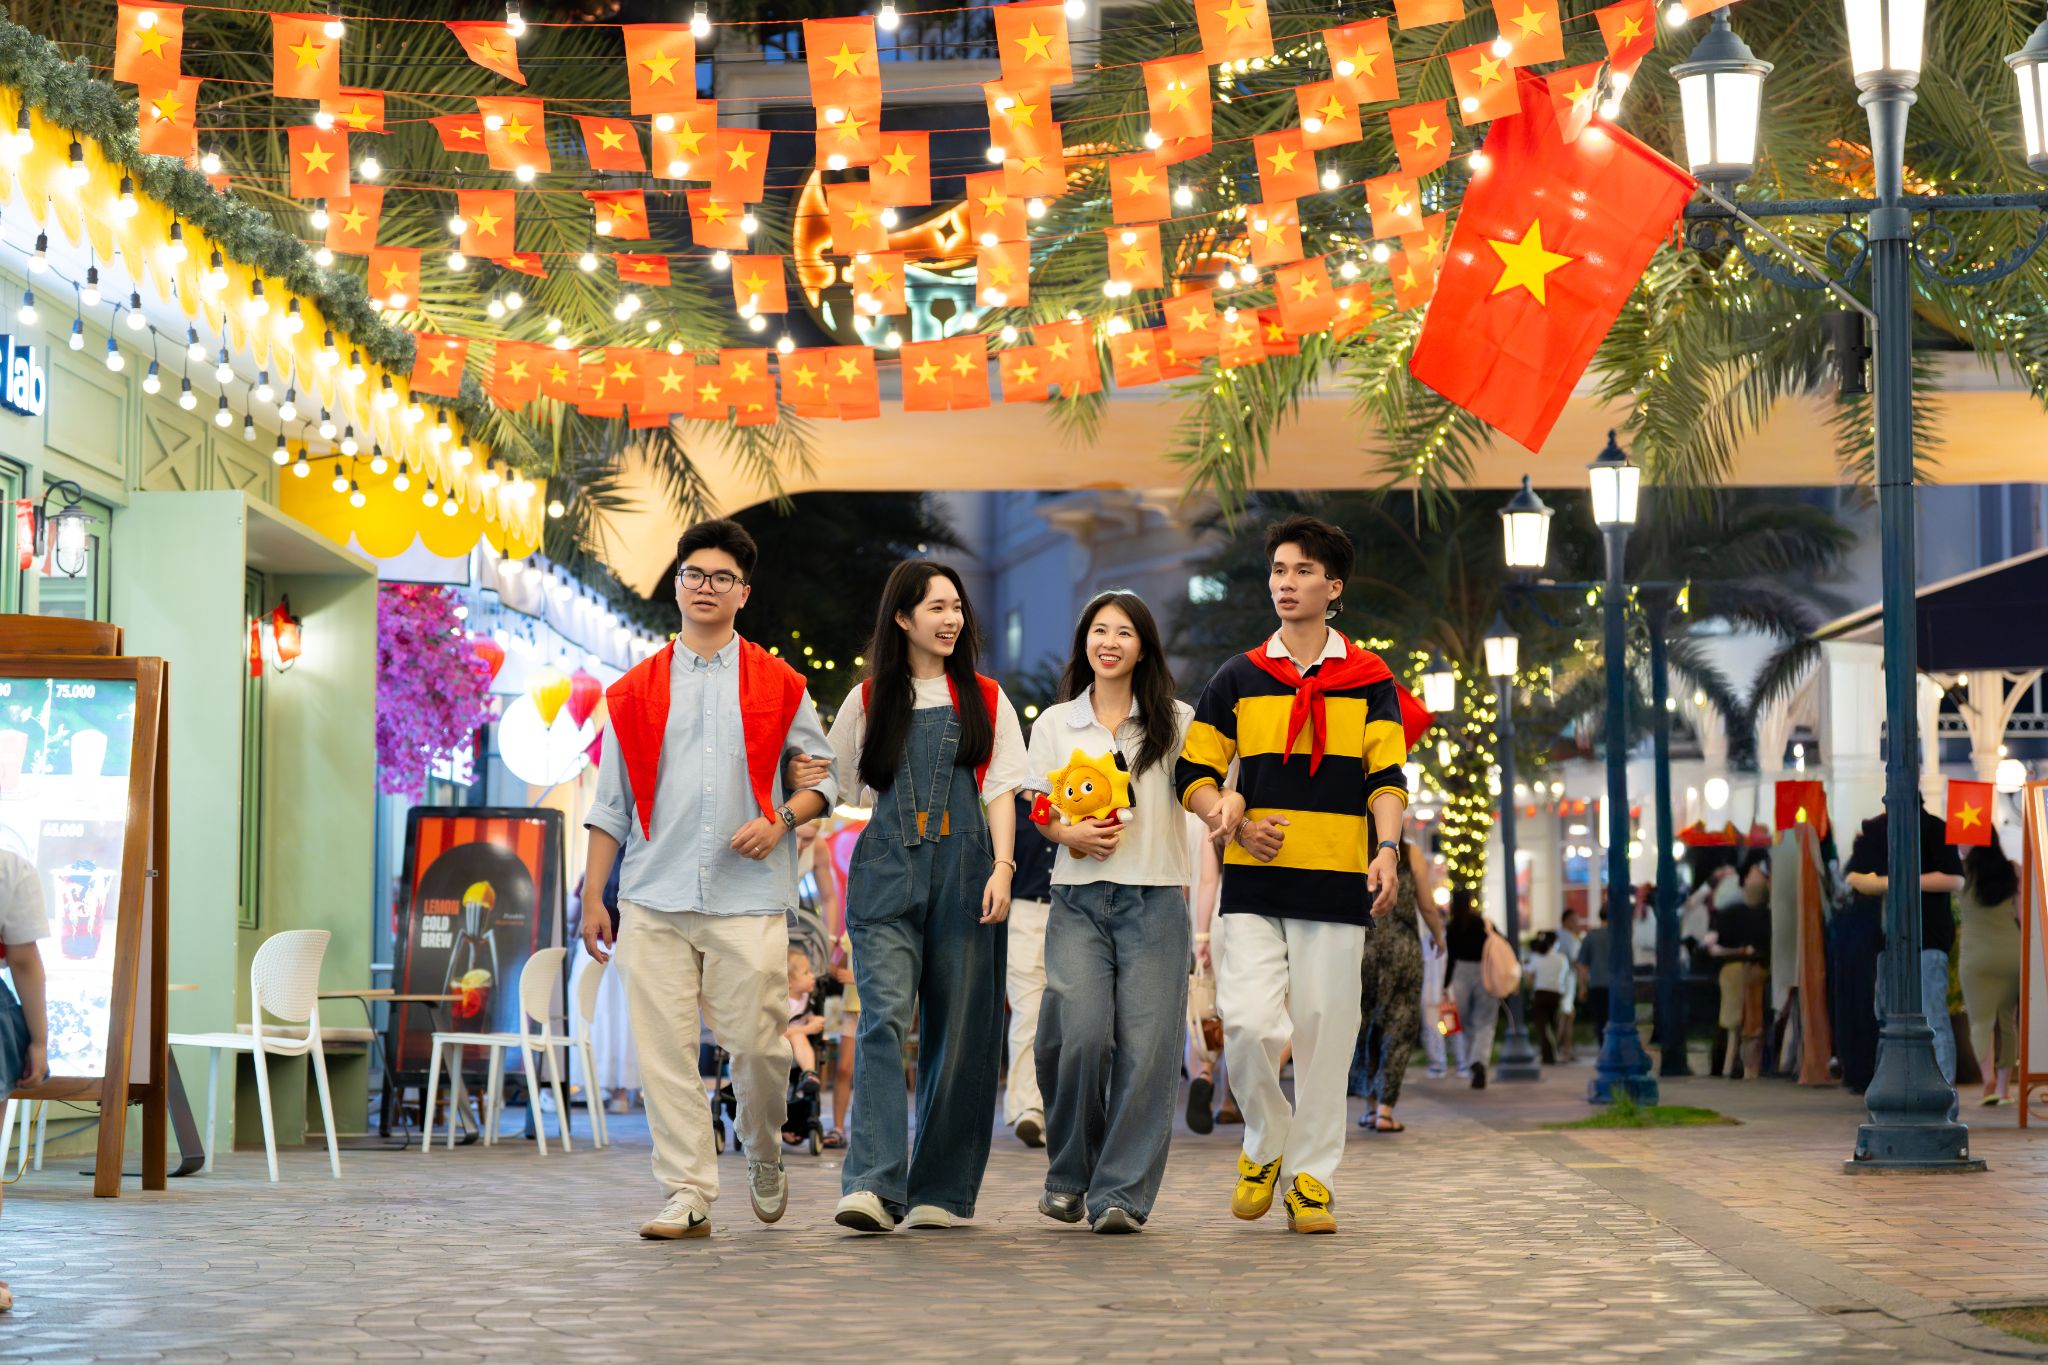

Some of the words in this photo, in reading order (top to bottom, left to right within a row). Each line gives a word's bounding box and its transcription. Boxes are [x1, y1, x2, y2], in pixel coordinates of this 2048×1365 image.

[6, 334, 46, 416] lab
[56, 684, 96, 699] 75.000
[424, 899, 460, 915] LEMON
[422, 915, 450, 931] COLD
[420, 932, 453, 948] BREW
